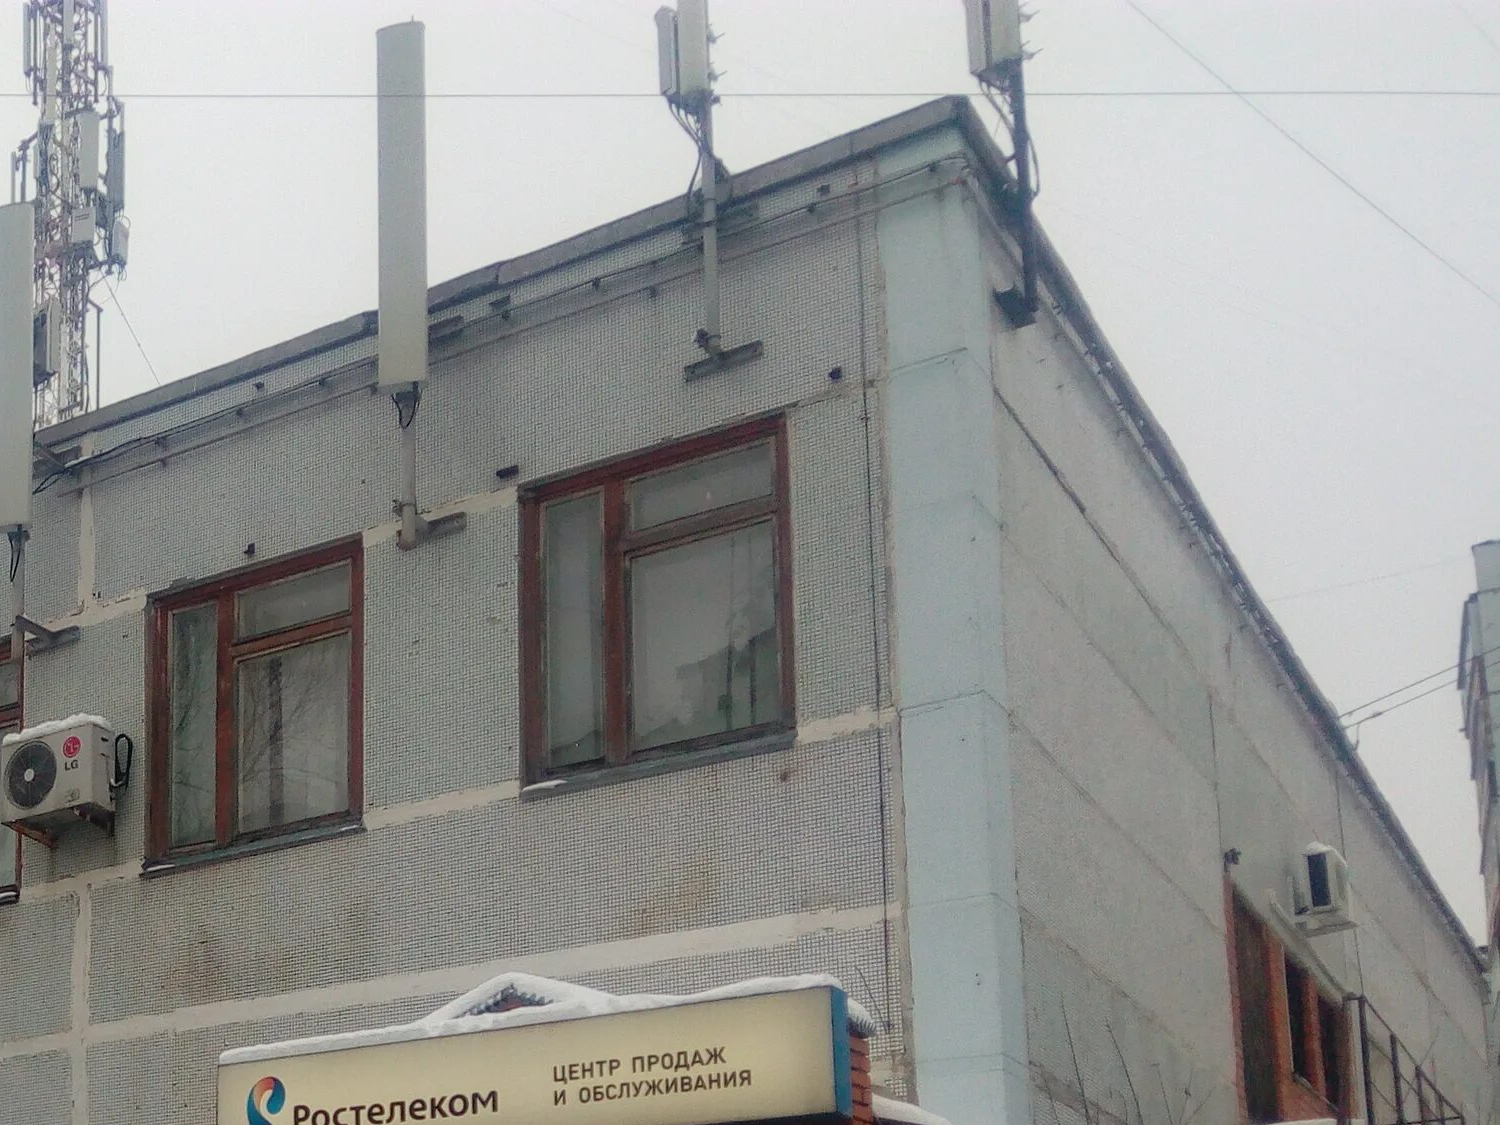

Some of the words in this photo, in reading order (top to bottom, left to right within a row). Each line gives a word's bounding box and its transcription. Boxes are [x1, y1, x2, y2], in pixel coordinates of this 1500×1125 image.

[64, 759, 79, 771] LG
[553, 1058, 621, 1085] ЦЕНТР
[632, 1046, 727, 1074] ПРОДАЖ
[553, 1089, 567, 1106] И
[578, 1069, 752, 1105] ОБСЛУЖИВАНИЯ
